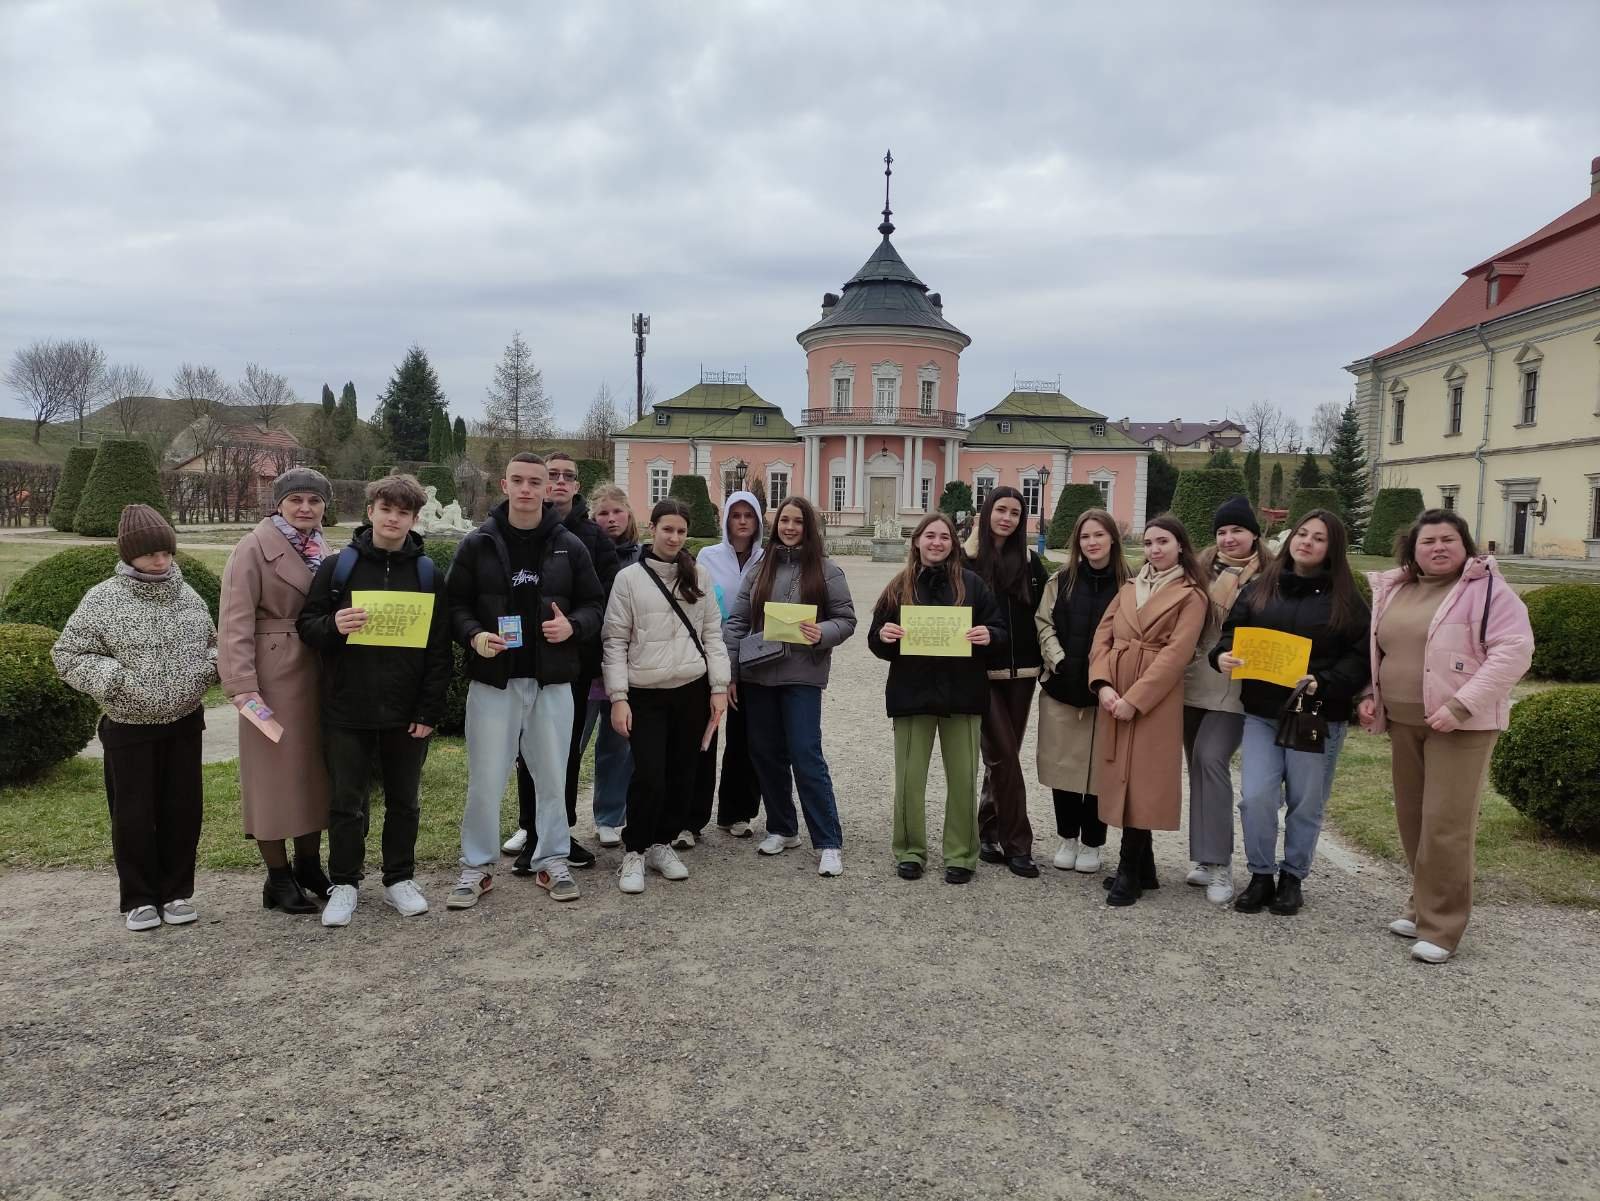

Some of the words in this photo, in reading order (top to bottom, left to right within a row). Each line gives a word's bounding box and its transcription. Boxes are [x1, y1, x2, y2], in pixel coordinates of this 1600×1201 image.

[907, 616, 966, 627] GLOBAL
[358, 625, 407, 637] WEEK
[908, 636, 951, 647] WEEK
